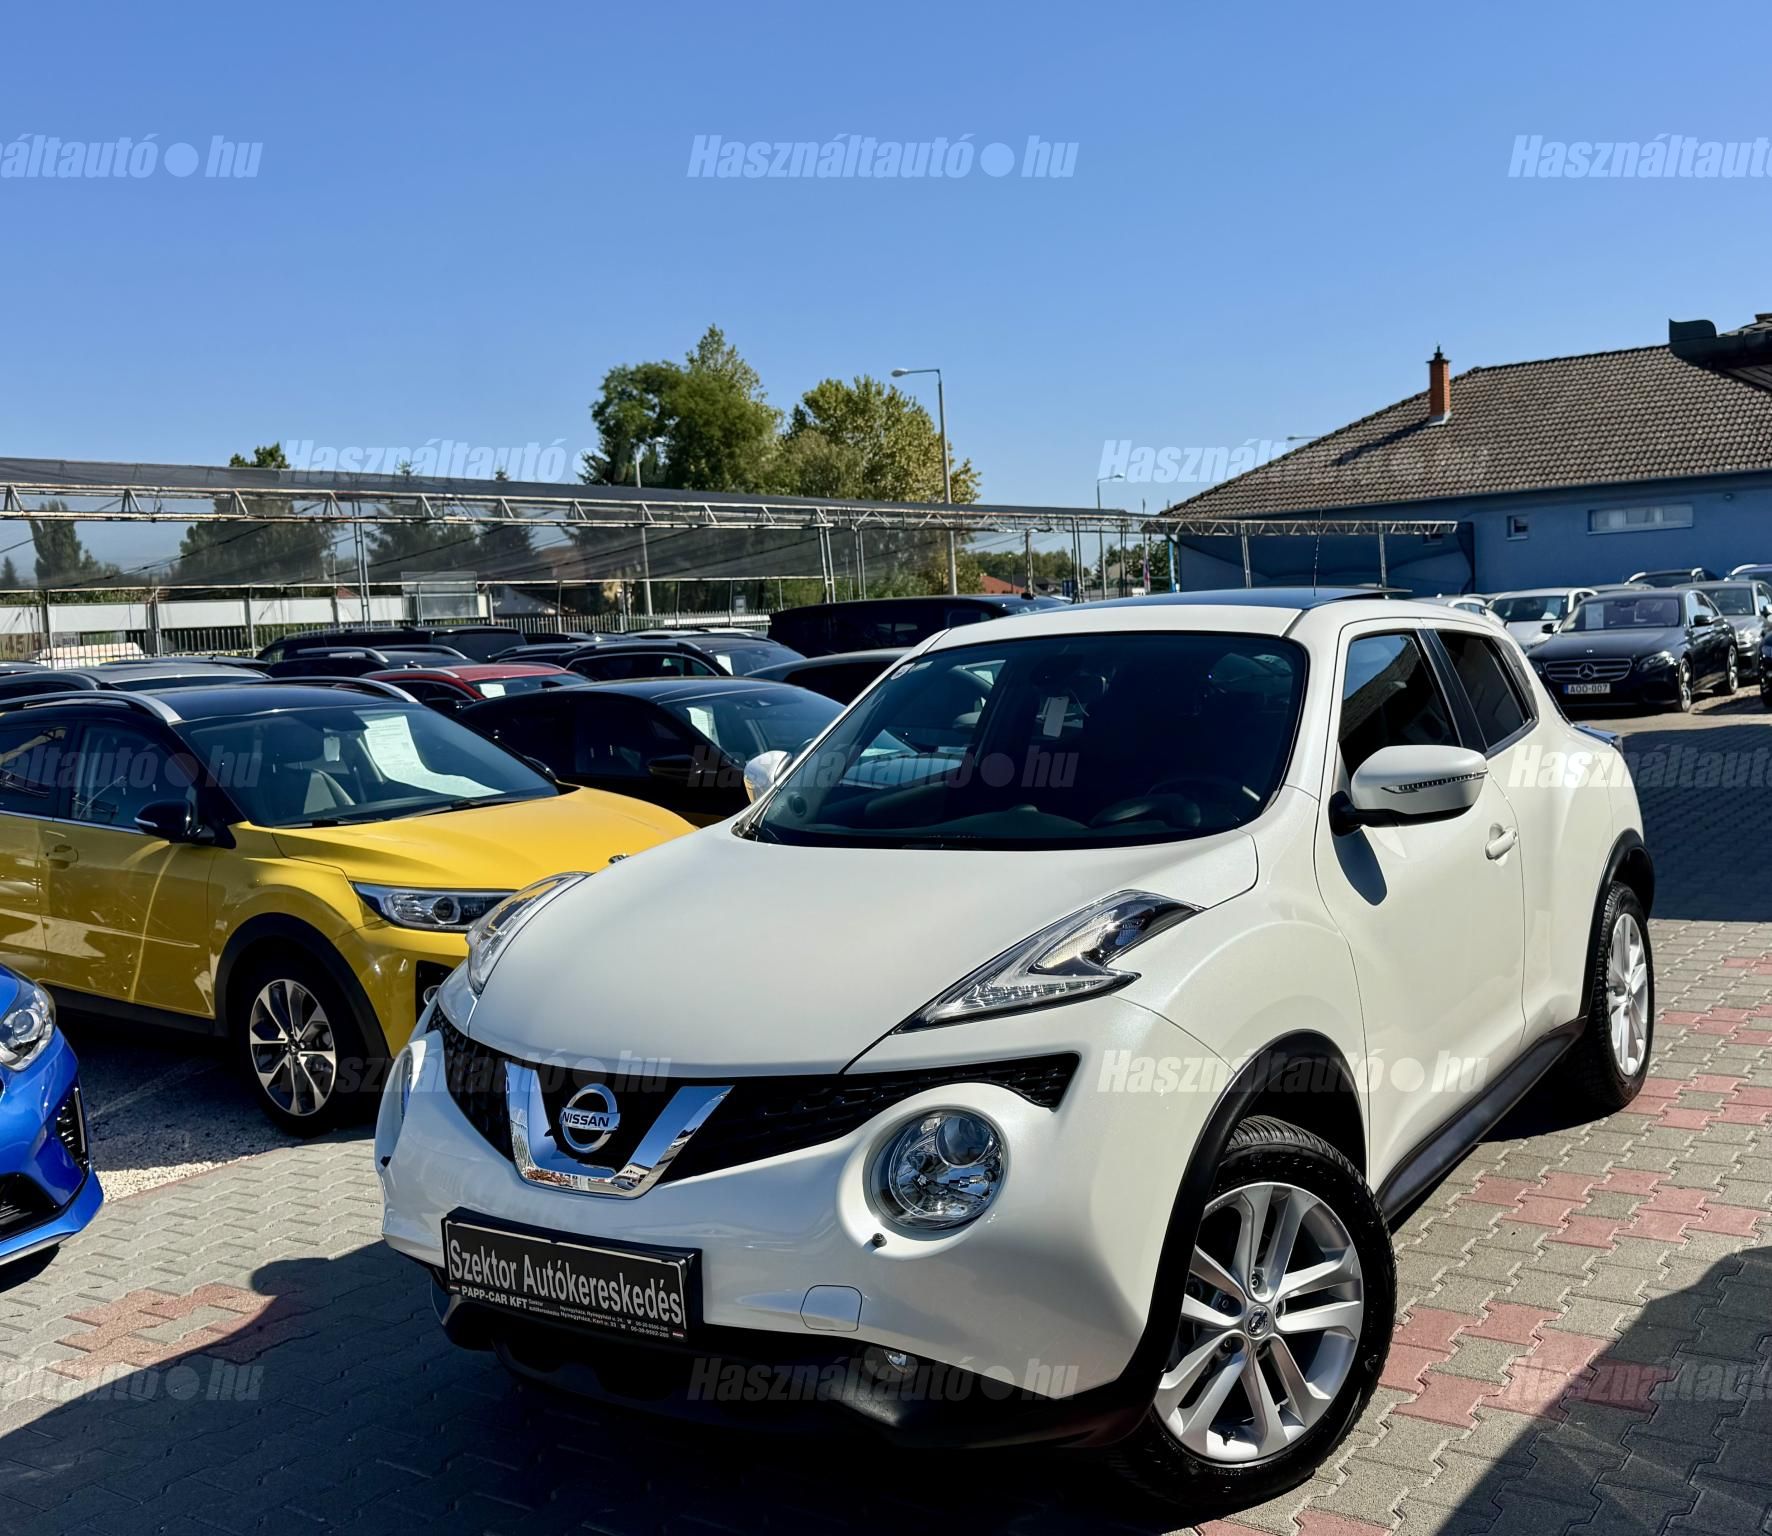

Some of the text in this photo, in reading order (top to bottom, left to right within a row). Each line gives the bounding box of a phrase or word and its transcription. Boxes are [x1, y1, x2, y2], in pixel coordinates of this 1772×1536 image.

[562, 1112, 609, 1127] NISSAN
[450, 1239, 682, 1324] Szektor Autókereskedés
[461, 1286, 527, 1309] PAPP-CAR KFT
